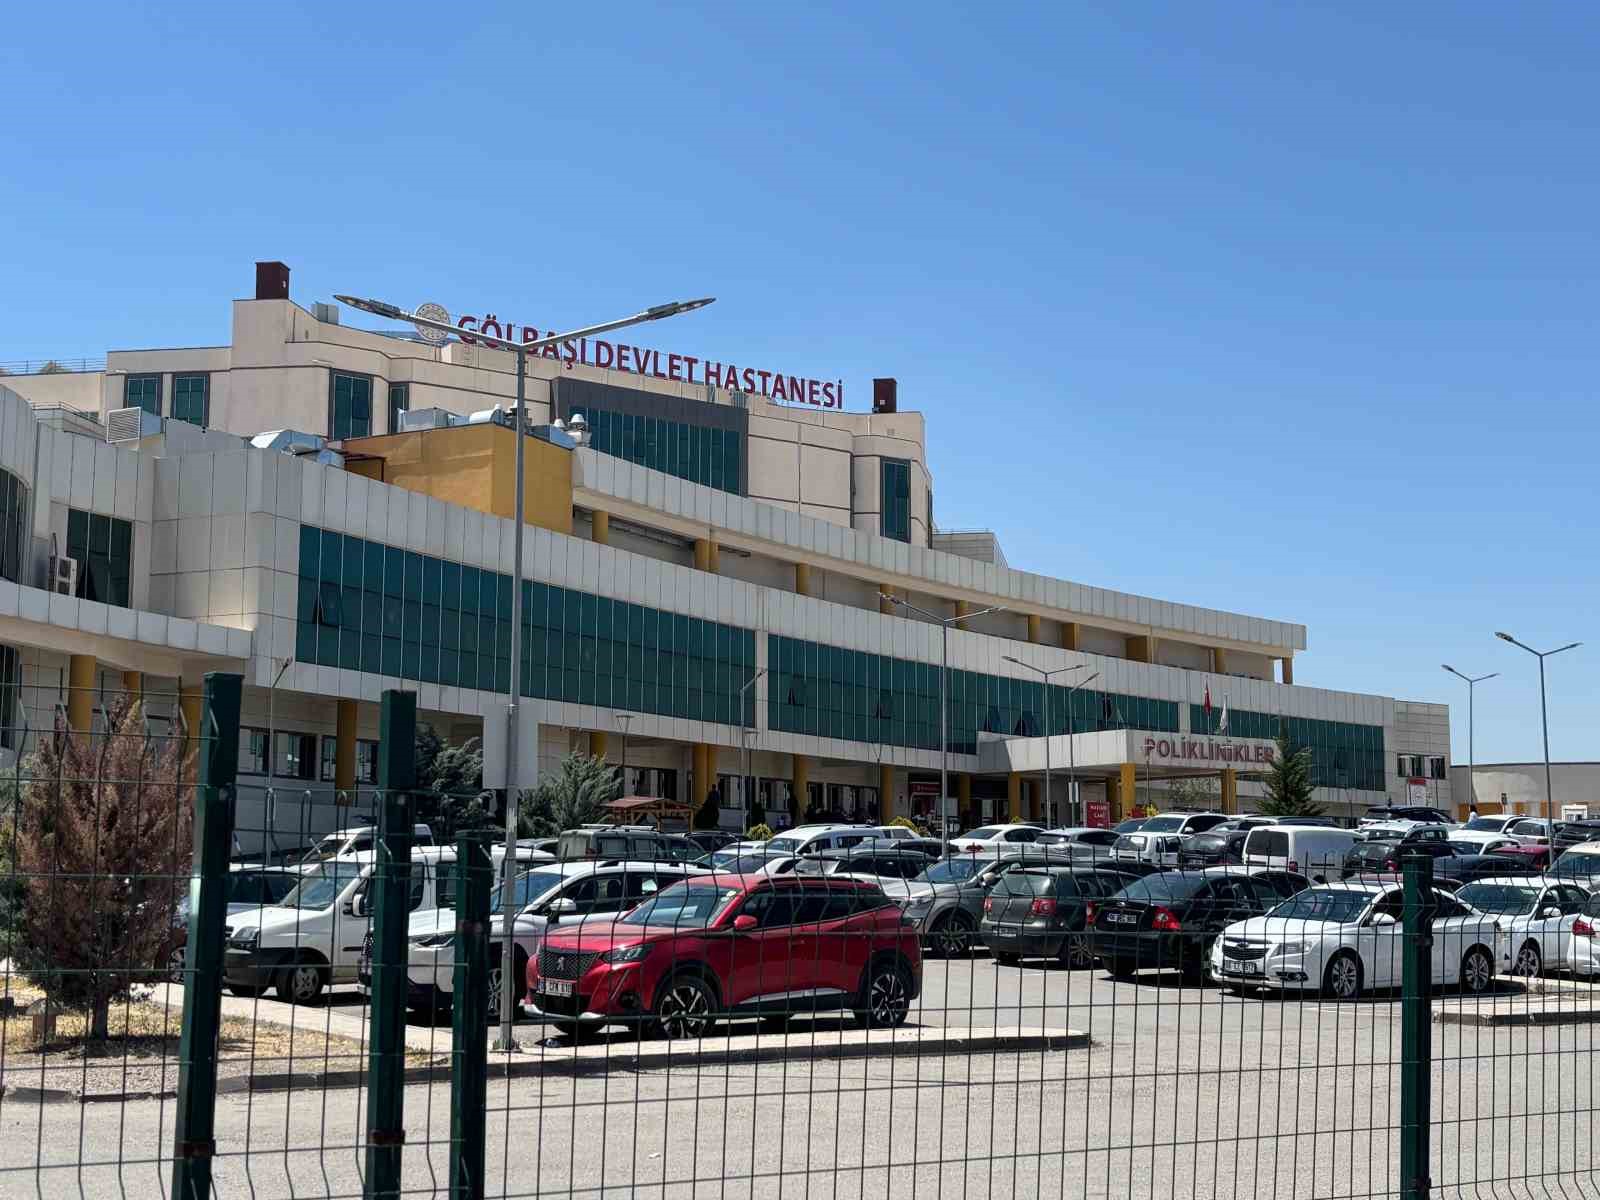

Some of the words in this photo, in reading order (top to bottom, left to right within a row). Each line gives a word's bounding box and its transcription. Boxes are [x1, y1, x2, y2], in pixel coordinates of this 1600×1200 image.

[595, 340, 698, 384] DEVLET
[704, 360, 843, 410] HASTANESİ
[1145, 736, 1274, 763] POLİKLİNİKLER
